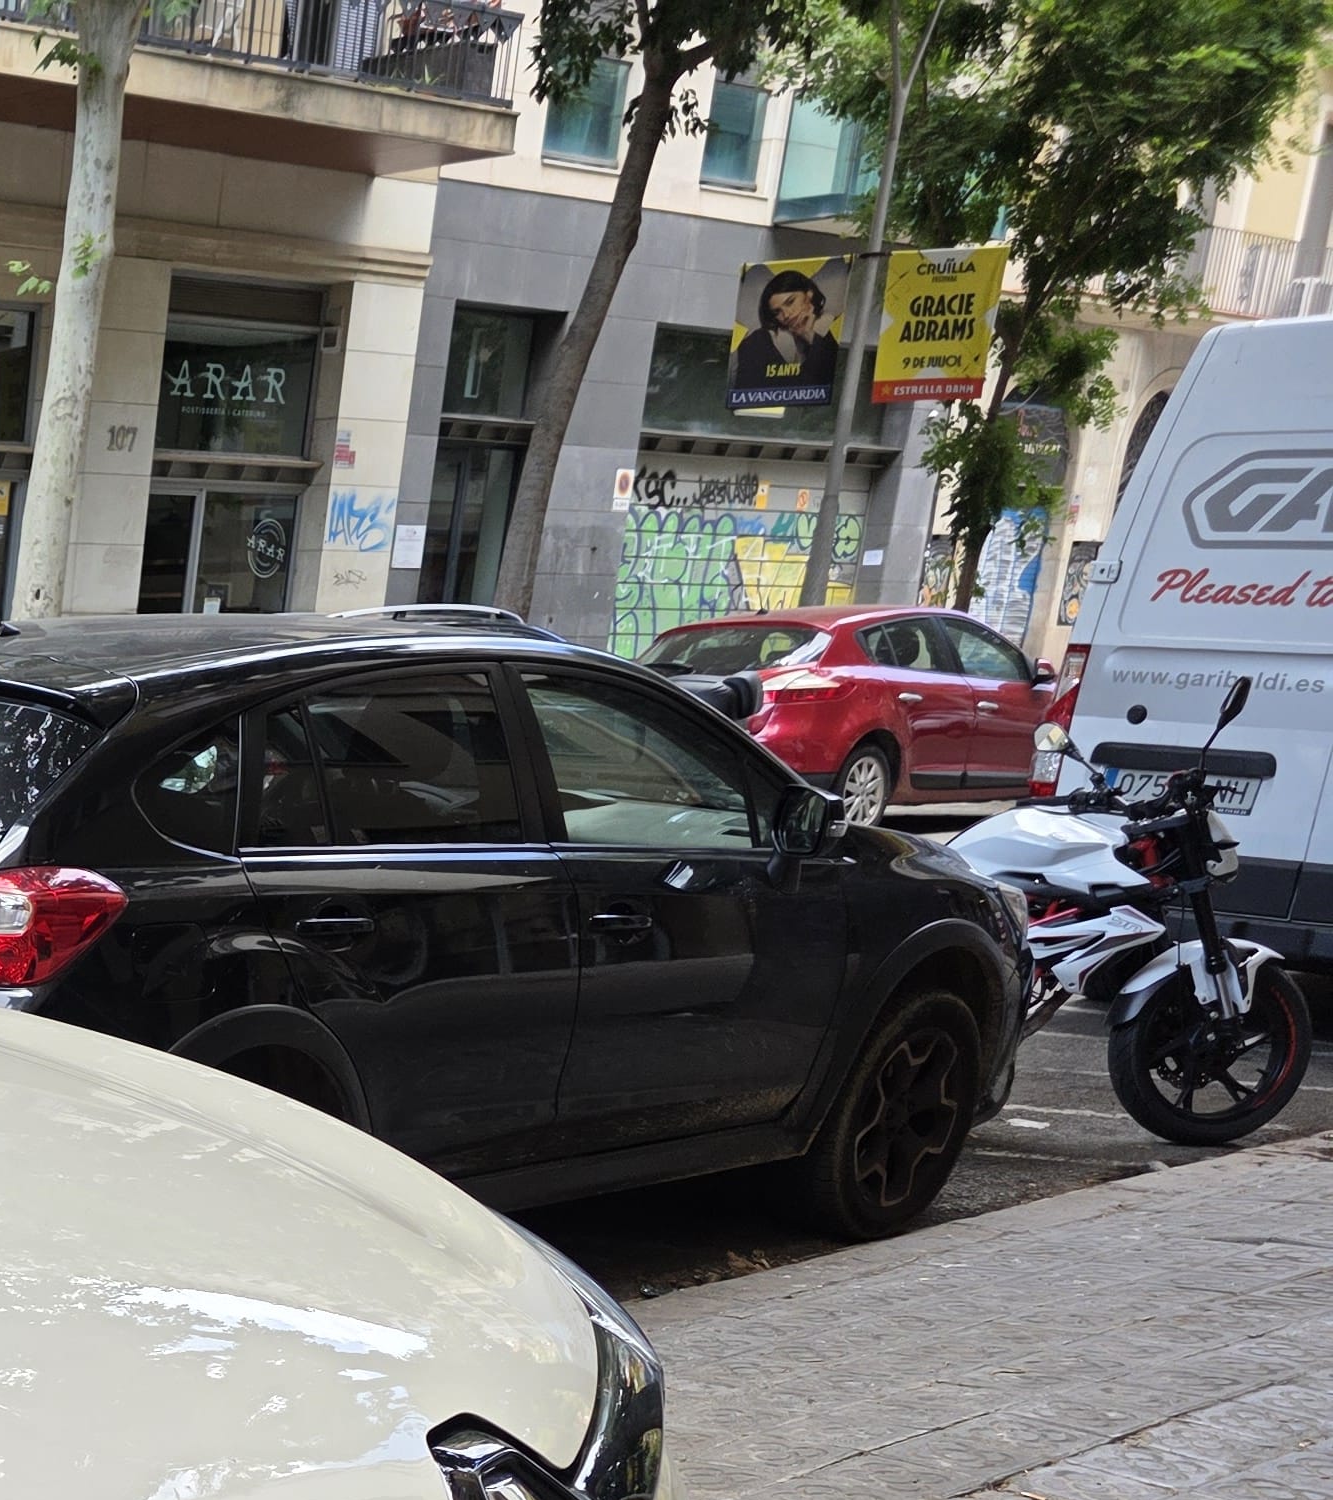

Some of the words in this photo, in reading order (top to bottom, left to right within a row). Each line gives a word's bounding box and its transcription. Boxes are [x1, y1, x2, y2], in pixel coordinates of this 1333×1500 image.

[909, 293, 976, 317] GRACIE
[899, 317, 976, 344] ABRAMS
[765, 364, 777, 377] 15
[777, 363, 801, 377] ANYS
[902, 357, 910, 369] 9
[913, 356, 925, 369] DE
[165, 359, 286, 404] ARAR
[894, 385, 943, 396] ESTRELLA
[732, 392, 746, 404] LA
[747, 388, 827, 403] VANGUARDIA
[107, 425, 138, 453] 107
[1204, 467, 1333, 533] GA
[246, 535, 286, 563] ARAR
[1150, 567, 1312, 608] Pleased
[1111, 666, 1326, 694] www.garibldi.es
[1118, 773, 1166, 799] 075
